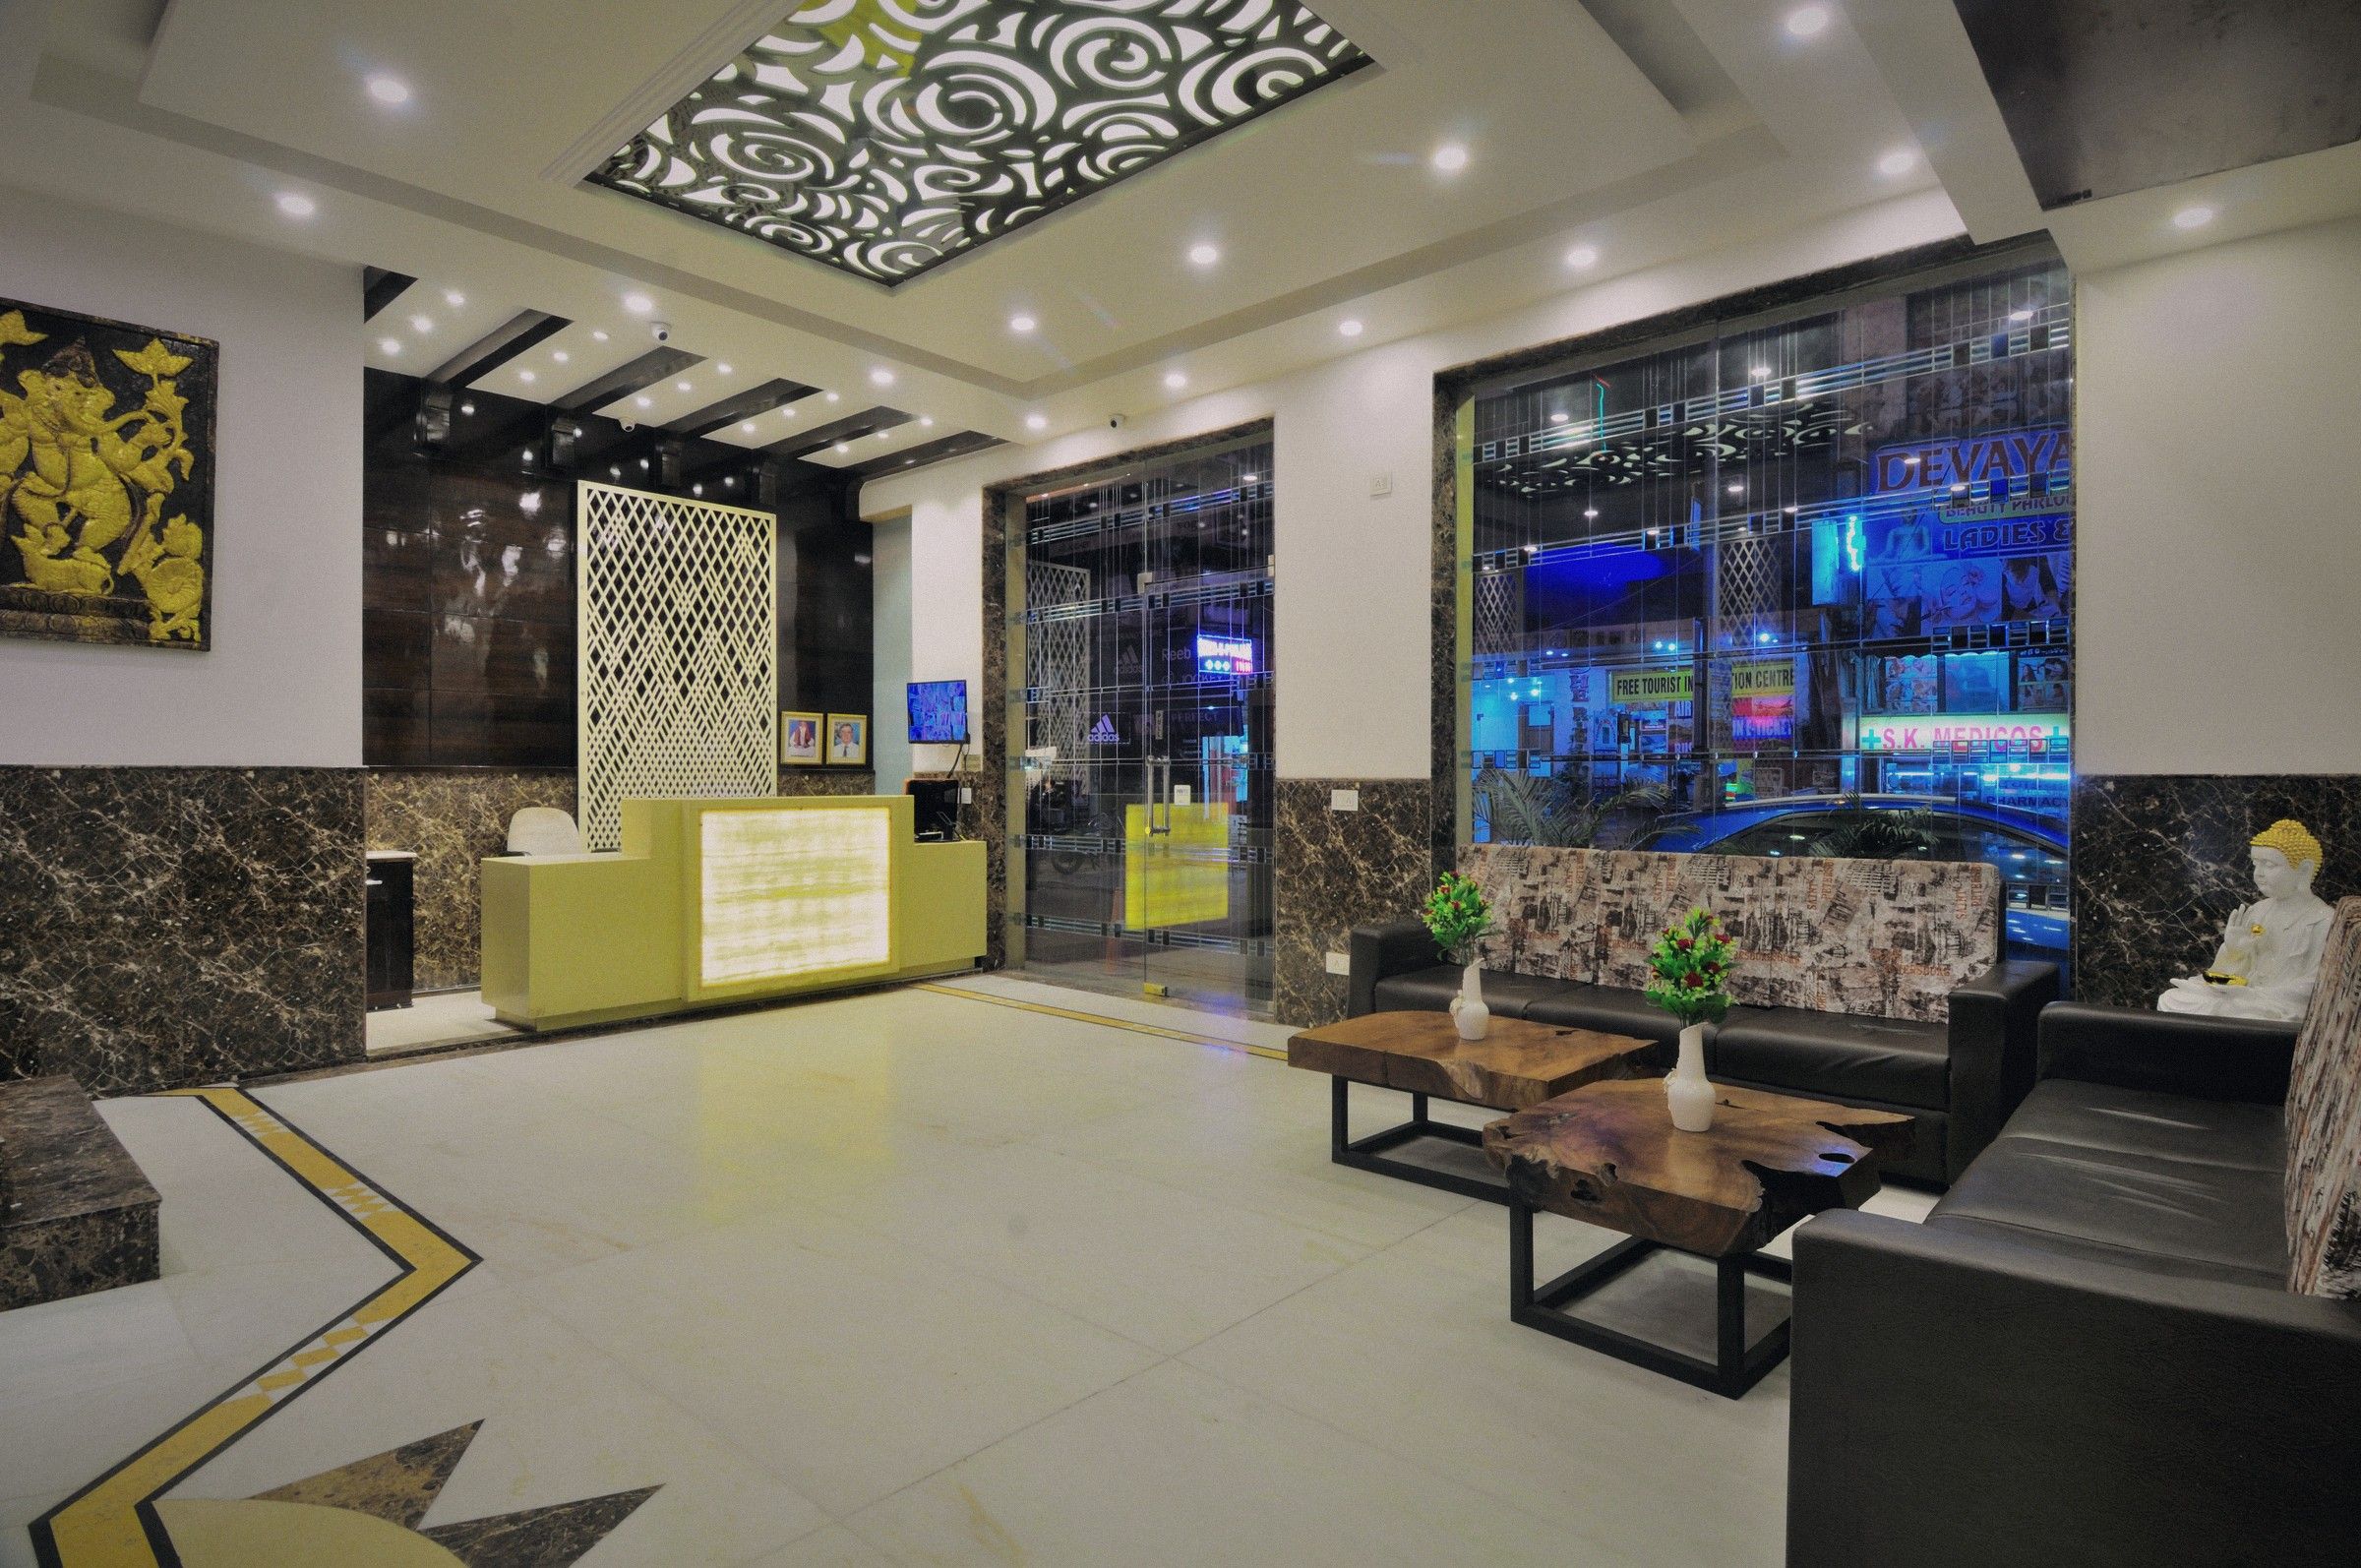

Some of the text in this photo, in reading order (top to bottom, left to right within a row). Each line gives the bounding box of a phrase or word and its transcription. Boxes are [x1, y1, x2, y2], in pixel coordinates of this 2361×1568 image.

[1877, 430, 2070, 492] DEVAYA
[2013, 496, 2070, 512] PARLO
[1944, 520, 2046, 552] LADIES
[1616, 678, 1640, 696] FREE
[1642, 676, 1681, 694] TOURIST
[1755, 668, 1793, 689] CENTRE
[1674, 700, 1692, 717] AIR
[1087, 731, 1120, 743] adidas
[1882, 725, 2044, 753] S.K. MEDICOS
